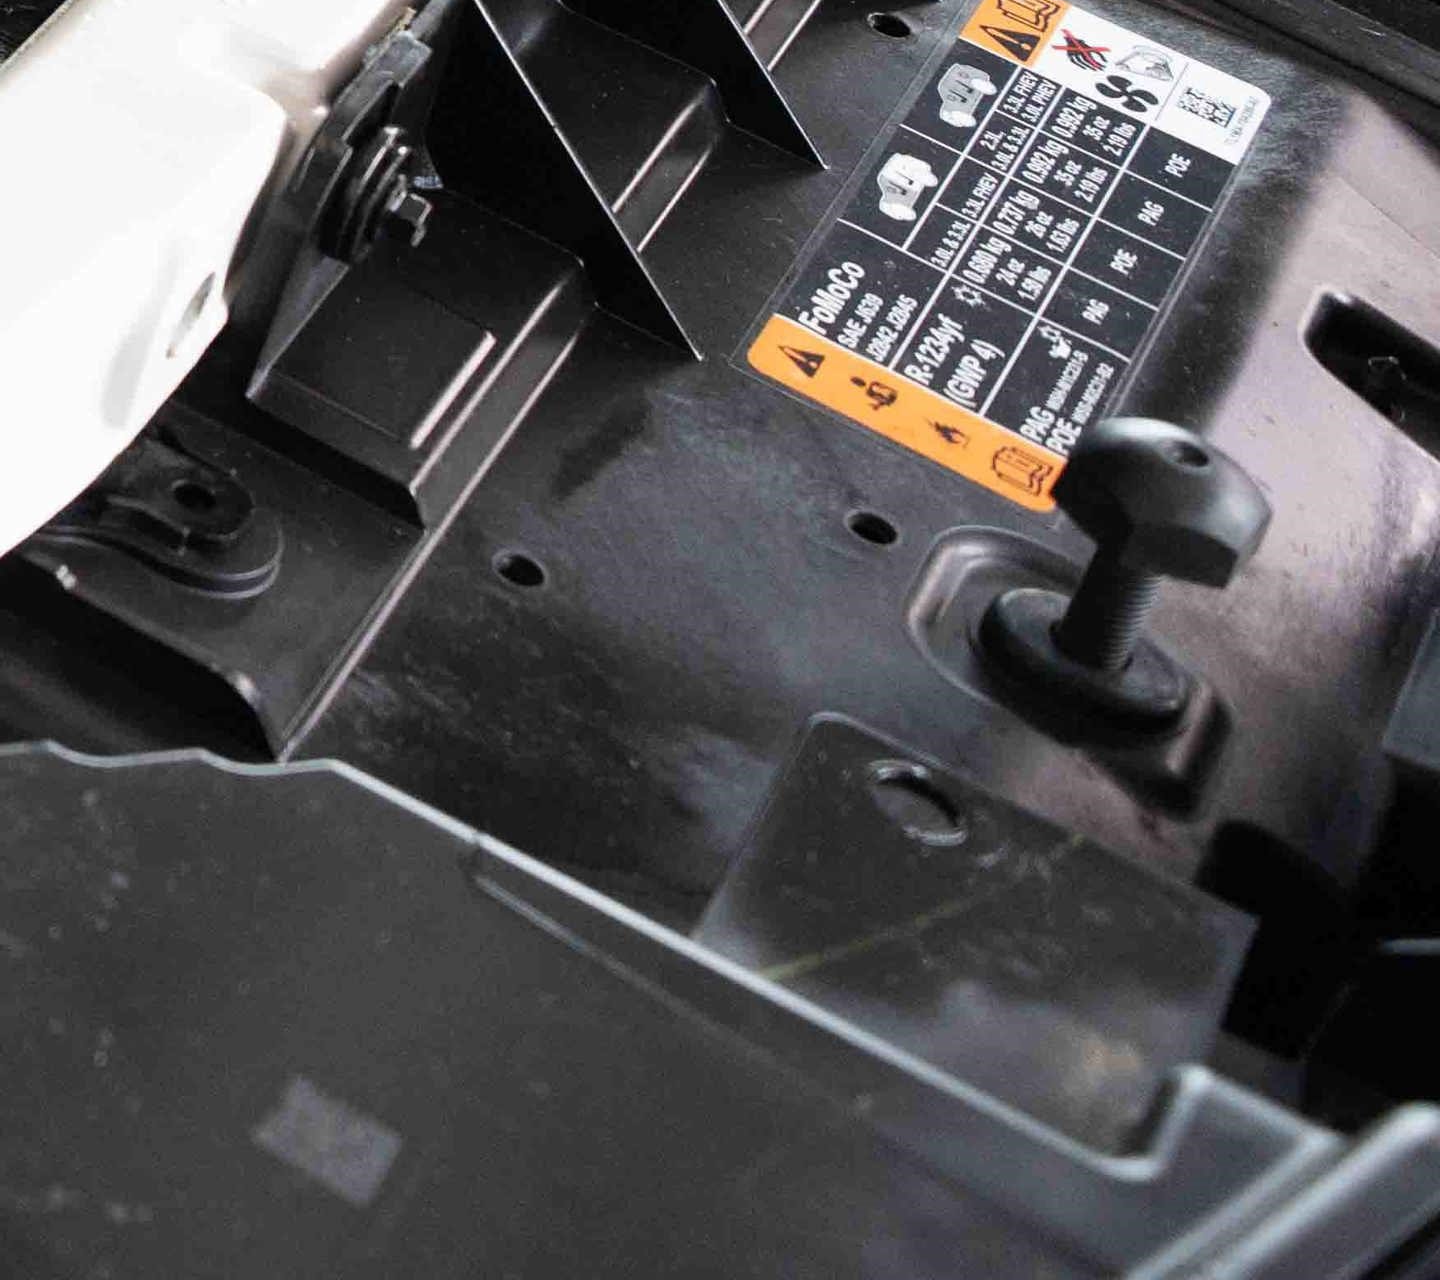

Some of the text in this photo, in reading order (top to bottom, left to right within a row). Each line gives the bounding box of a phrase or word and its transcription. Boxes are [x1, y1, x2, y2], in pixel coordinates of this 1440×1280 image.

[1003, 71, 1037, 113] 3.3L FHEV
[1020, 79, 1055, 122] 3.0L PHEV
[1051, 96, 1096, 137] 0.992 kg
[1082, 115, 1109, 140] 35 oz
[991, 151, 1014, 170] 3.0L
[1007, 126, 1029, 144] 3.3L
[1102, 122, 1135, 156] 2.19 lbs
[1022, 139, 1068, 183] 0.992 kg
[1053, 160, 1081, 185] 35 oz
[1165, 153, 1190, 177] POE
[961, 172, 997, 217] 3.3L FHEV
[1074, 167, 1107, 202] 2.19 lbs
[992, 190, 1039, 234] 0.737 kg
[1024, 211, 1053, 237] 26 oz
[1137, 201, 1163, 225] PAG
[930, 247, 954, 267] 3.0L
[947, 220, 970, 240] 3.3L
[1046, 218, 1079, 252] 1.63 lbs
[963, 236, 1011, 283] 0.680 kg
[995, 258, 1024, 285] 24 oz
[1110, 249, 1136, 274] POE
[799, 262, 863, 333] FoMoCo
[1017, 266, 1051, 300] 1.50 lbs
[837, 293, 882, 347] SAE J639
[1082, 299, 1108, 323] PAG
[904, 313, 963, 384] R-1234yf
[944, 339, 1004, 406] (GWP 4)
[1020, 406, 1054, 441] PAG
[1046, 418, 1081, 454] POE
